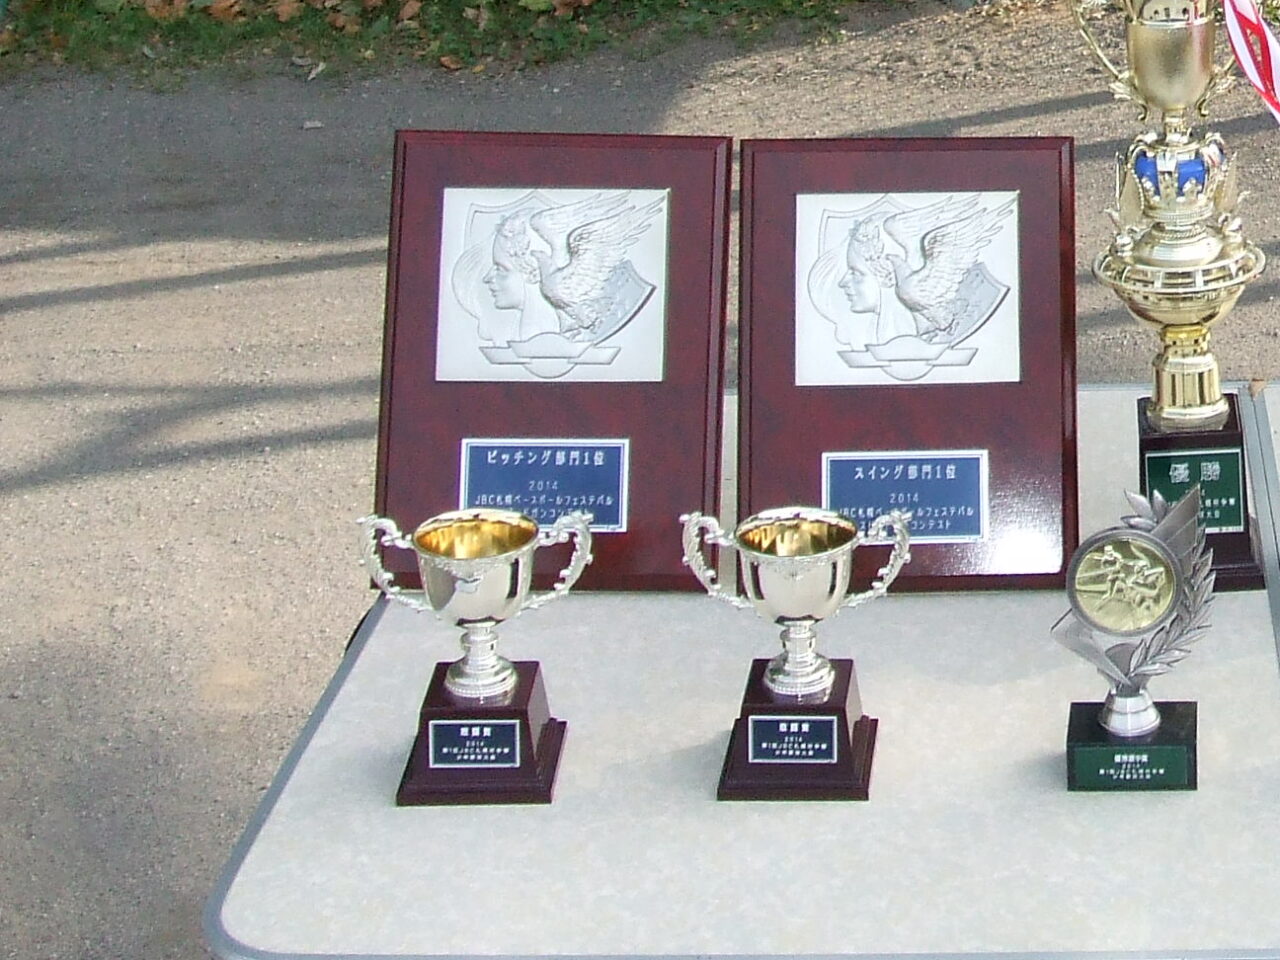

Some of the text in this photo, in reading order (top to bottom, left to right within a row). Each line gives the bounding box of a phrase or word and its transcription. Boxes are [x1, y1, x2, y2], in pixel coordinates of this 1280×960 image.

[486, 449, 605, 466] ピッチング部門1位
[854, 463, 956, 480] スイング部門1位
[1169, 461, 1221, 483] 優勝
[529, 480, 558, 491] 2014
[889, 493, 919, 504] 2014
